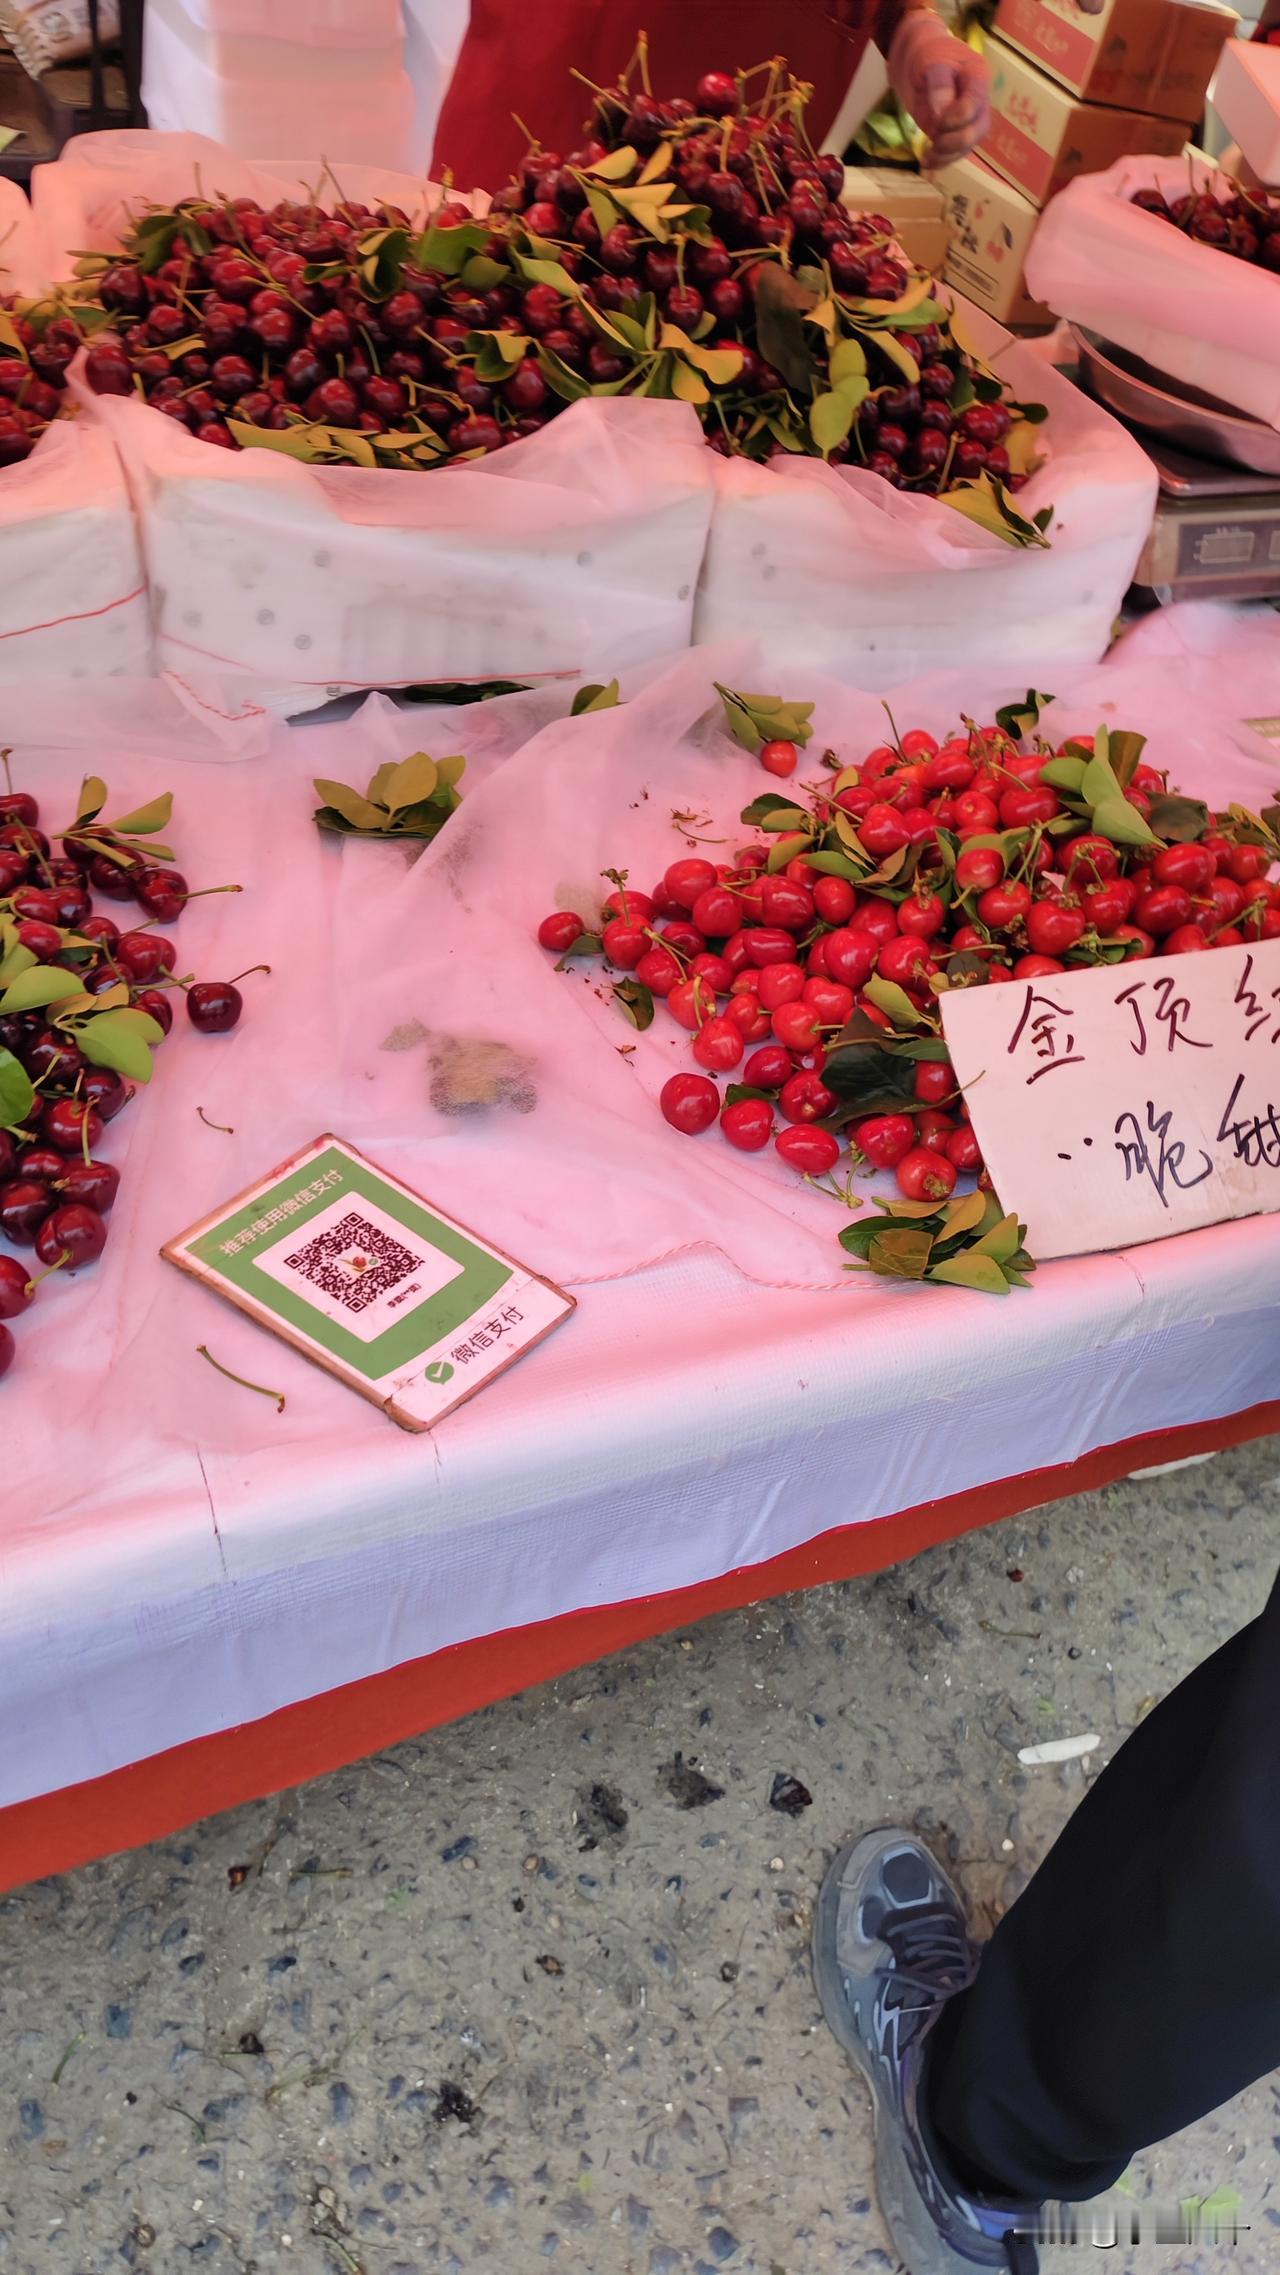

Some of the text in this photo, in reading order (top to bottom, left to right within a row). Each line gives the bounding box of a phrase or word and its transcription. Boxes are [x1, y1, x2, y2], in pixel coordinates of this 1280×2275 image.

[219, 1168, 344, 1257] 推荐使用微信支付
[450, 1306, 524, 1365] 微信支付
